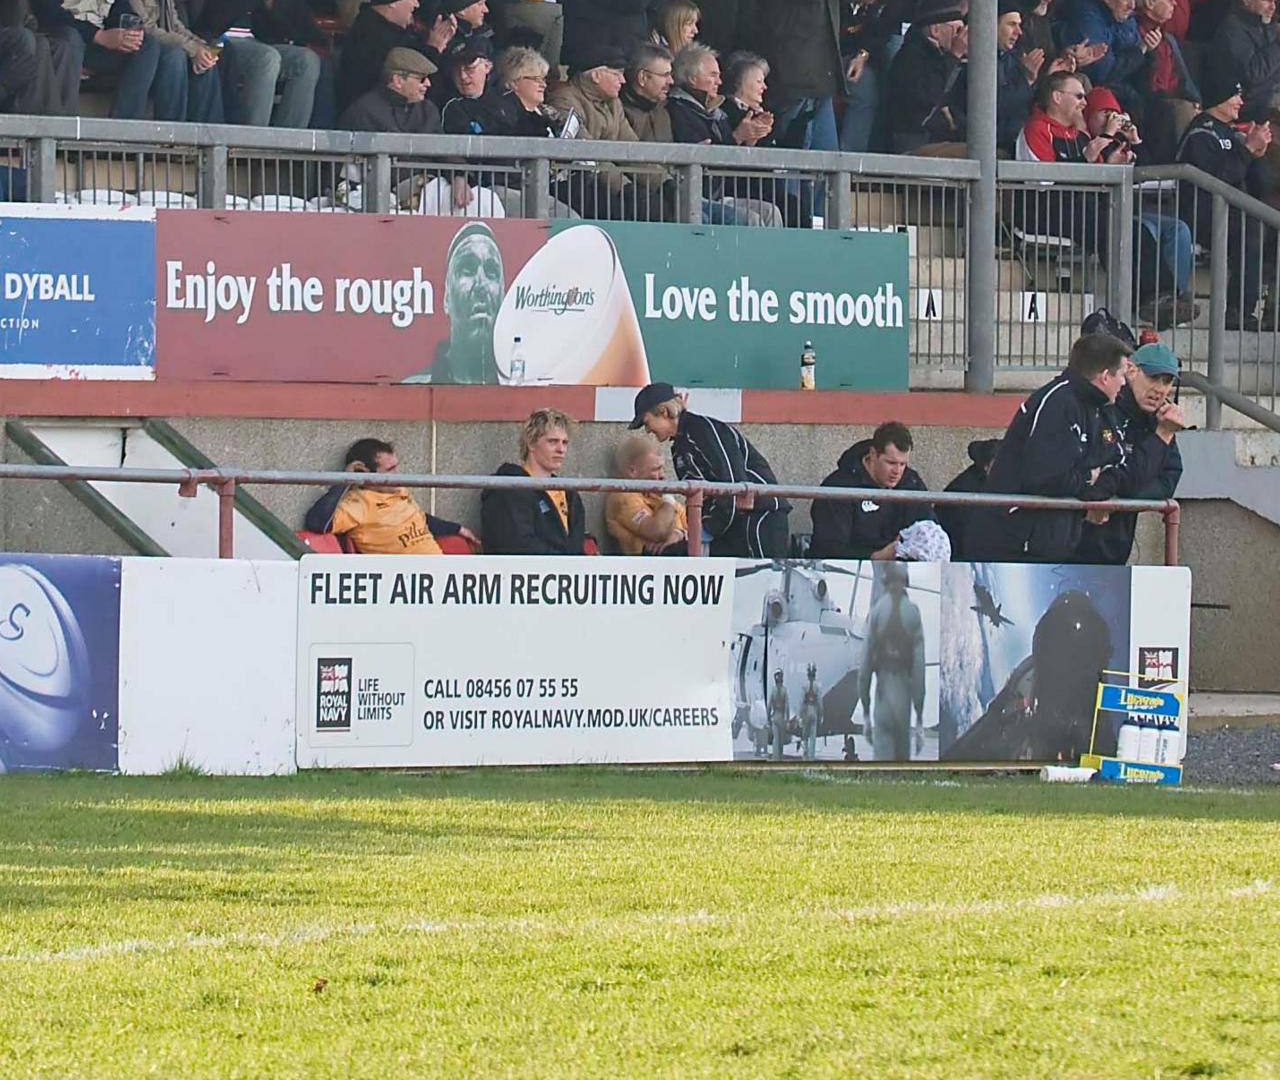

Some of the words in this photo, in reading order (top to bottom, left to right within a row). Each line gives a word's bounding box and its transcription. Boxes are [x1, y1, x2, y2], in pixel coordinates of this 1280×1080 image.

[4, 273, 95, 301] DYBALL
[166, 260, 257, 325] Enjoy
[266, 263, 324, 313] the
[335, 267, 435, 328] rough
[644, 273, 717, 322] Love
[727, 276, 782, 325] the
[788, 283, 904, 328] smooth
[310, 573, 383, 606] FLEET
[390, 573, 435, 606] AIR
[442, 573, 503, 606] ARM
[510, 573, 655, 606] RECRUITING
[662, 573, 725, 606] NOW
[358, 678, 379, 692] LIFE
[424, 678, 462, 699] CALL
[466, 678, 512, 699] 08456
[516, 678, 534, 698] 07
[538, 678, 557, 698] 55
[561, 678, 579, 698] 55
[320, 695, 348, 708] ROYAL
[357, 692, 406, 706] WITHOUT
[320, 707, 348, 722] NAVY
[357, 706, 392, 720] LIMITS
[423, 710, 445, 730] OR
[449, 709, 487, 730] VISIT
[491, 707, 719, 730] ROYALNAVY.MOD.UK/CAREERS
